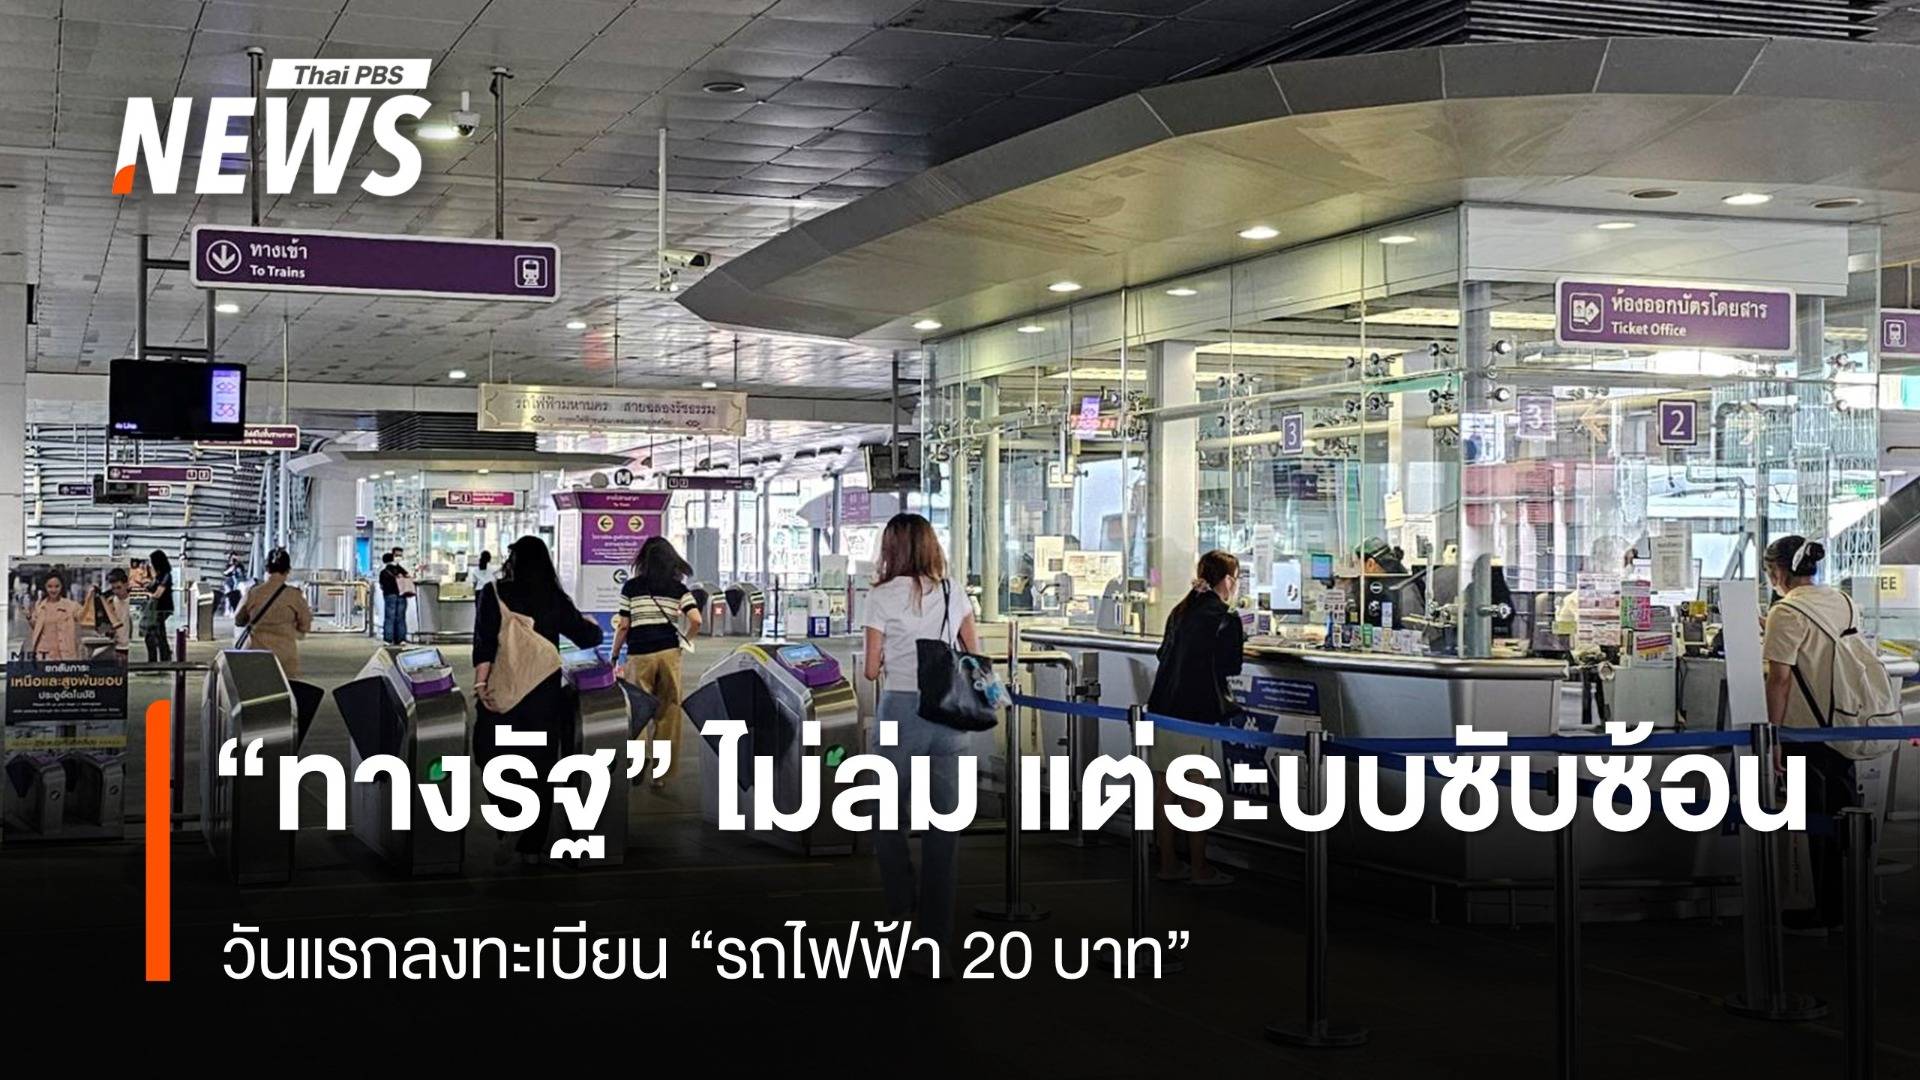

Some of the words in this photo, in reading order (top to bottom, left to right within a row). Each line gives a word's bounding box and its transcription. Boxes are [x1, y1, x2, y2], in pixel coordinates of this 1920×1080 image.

[249, 237, 308, 260] ทางเข้า
[249, 264, 266, 277] To
[267, 265, 306, 279] Trains
[1611, 288, 1769, 319] ห้องออกบัตรโดยสาร
[1611, 321, 1649, 336] Ticket
[1650, 323, 1687, 337] Office
[515, 395, 609, 411] รถไฟฟ้ามหานคร
[1287, 421, 1298, 446] 3
[1670, 411, 1685, 437] 2
